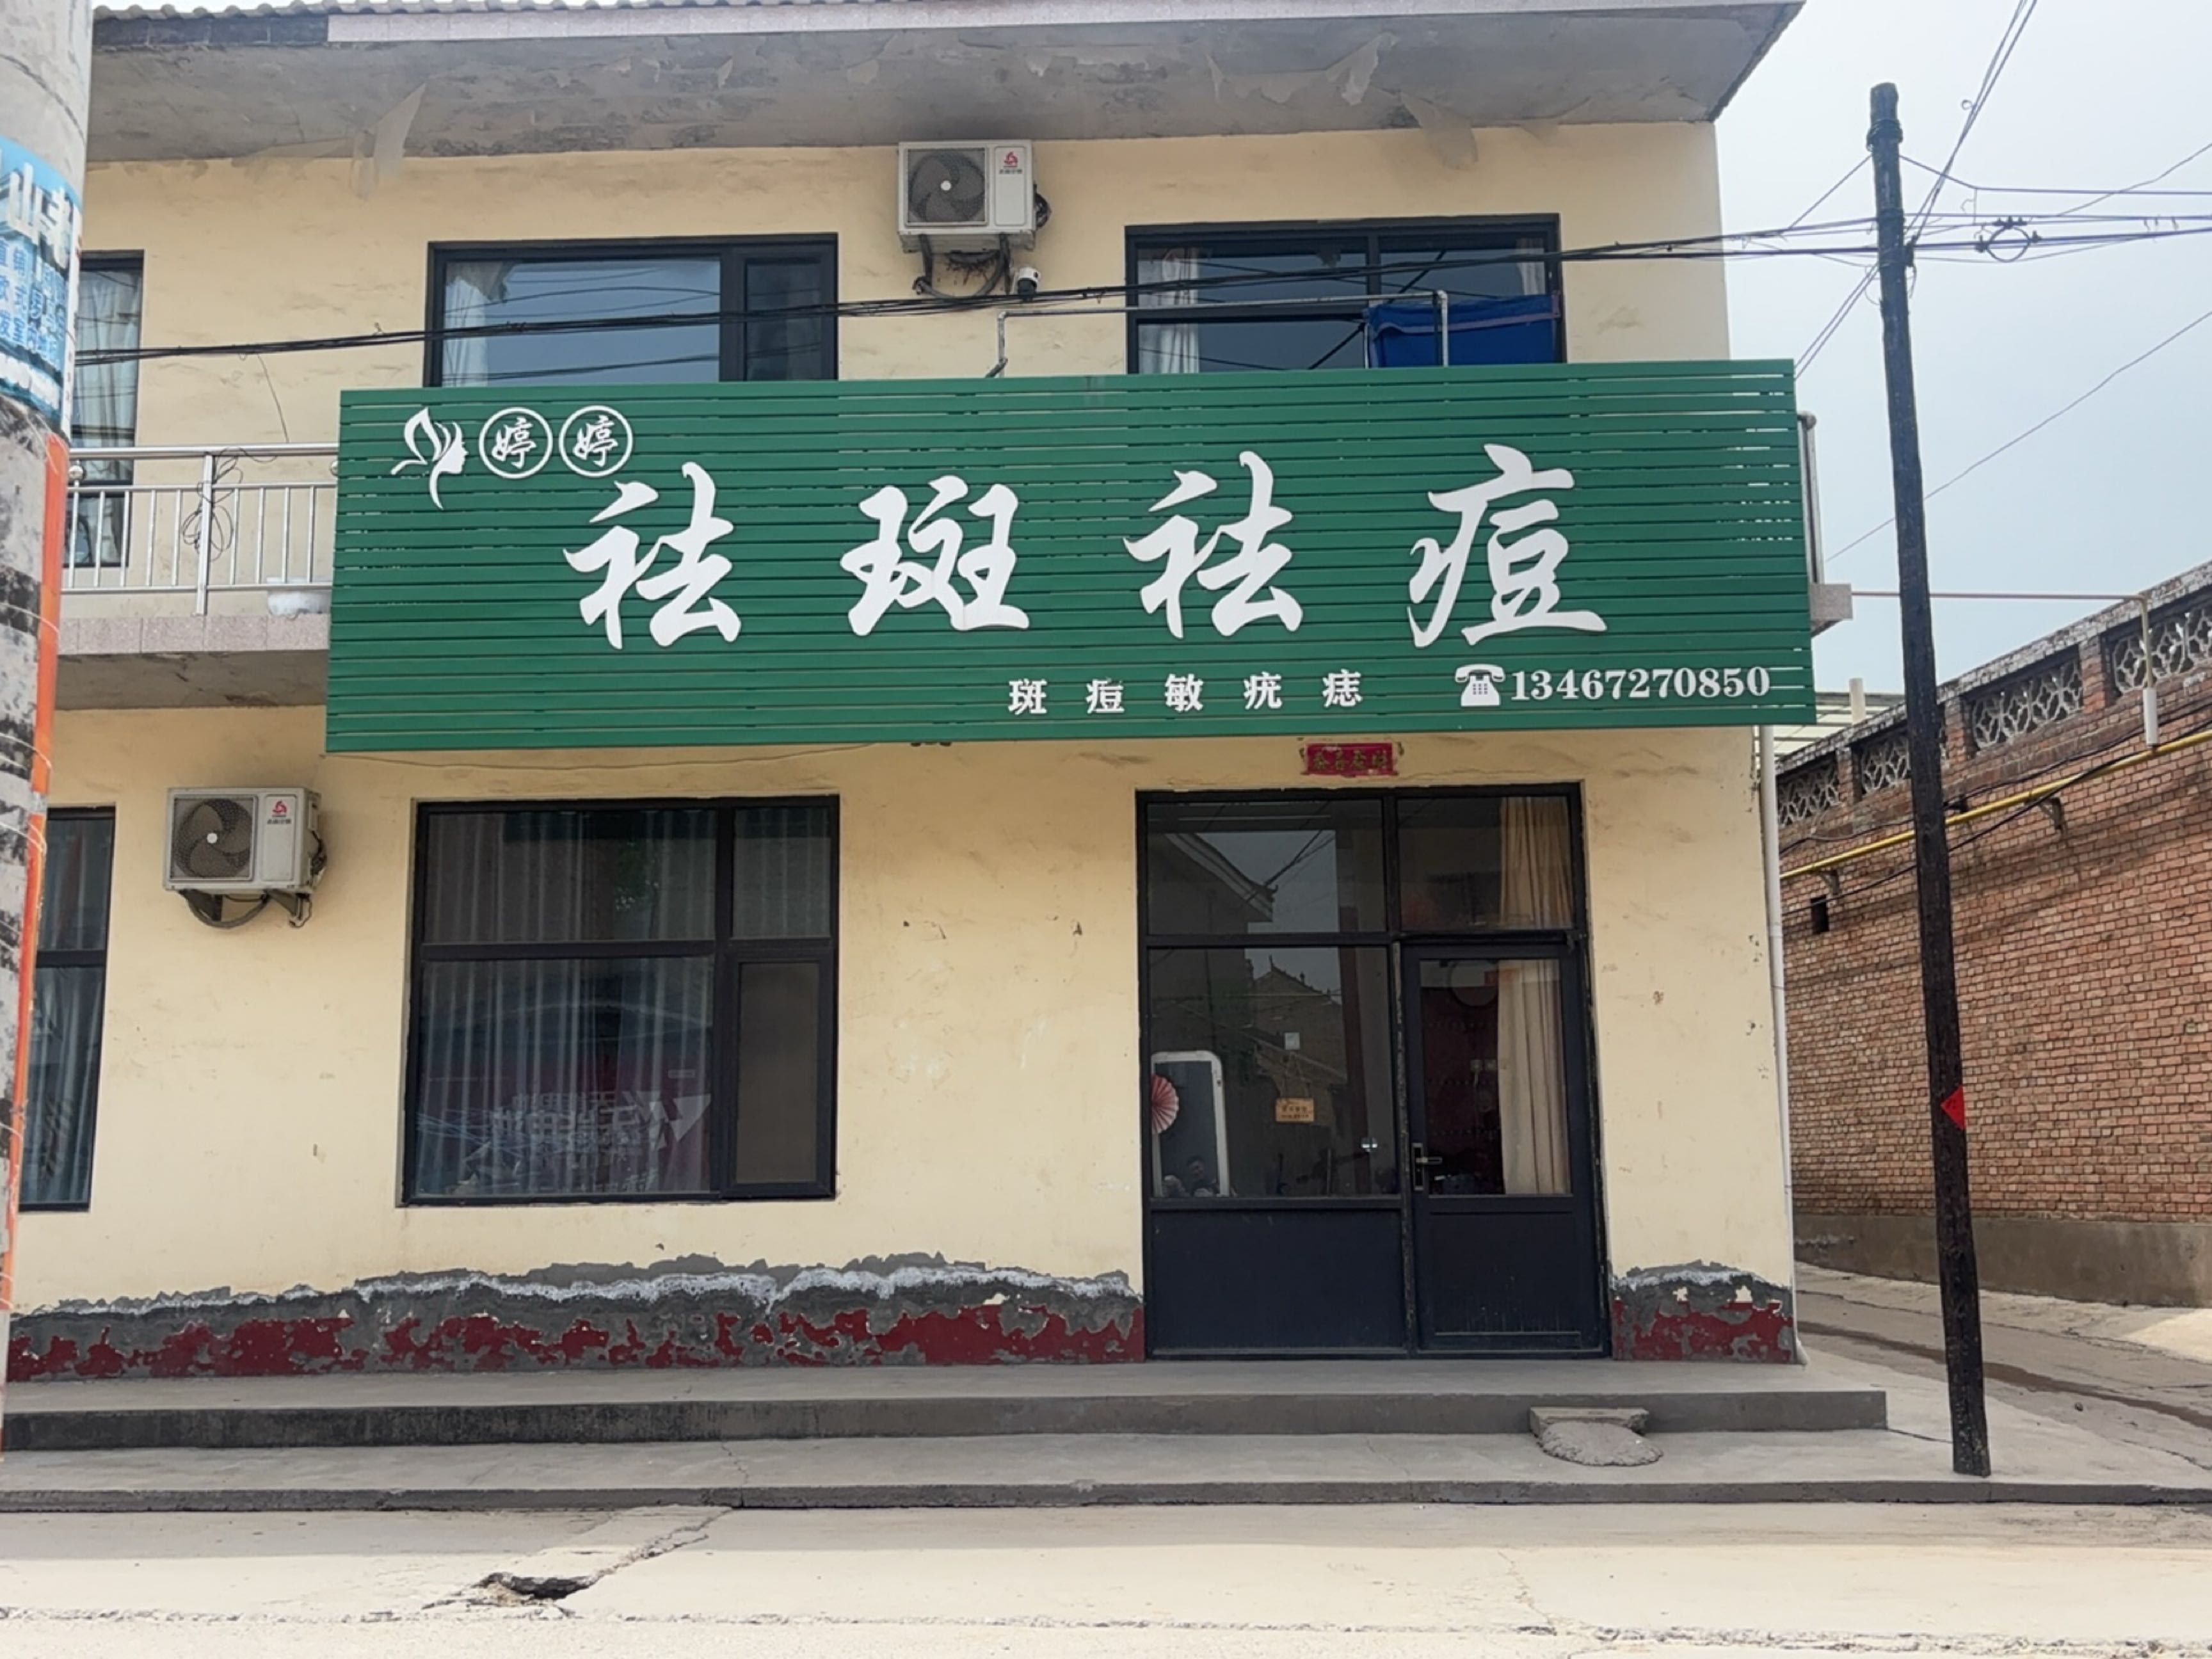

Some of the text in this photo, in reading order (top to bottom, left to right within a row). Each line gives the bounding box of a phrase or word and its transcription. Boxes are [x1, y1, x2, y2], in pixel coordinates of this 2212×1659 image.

[488, 411, 622, 471] 婷婷
[563, 444, 1607, 650] 祛斑祛痘
[1511, 667, 1770, 700] 13467270850
